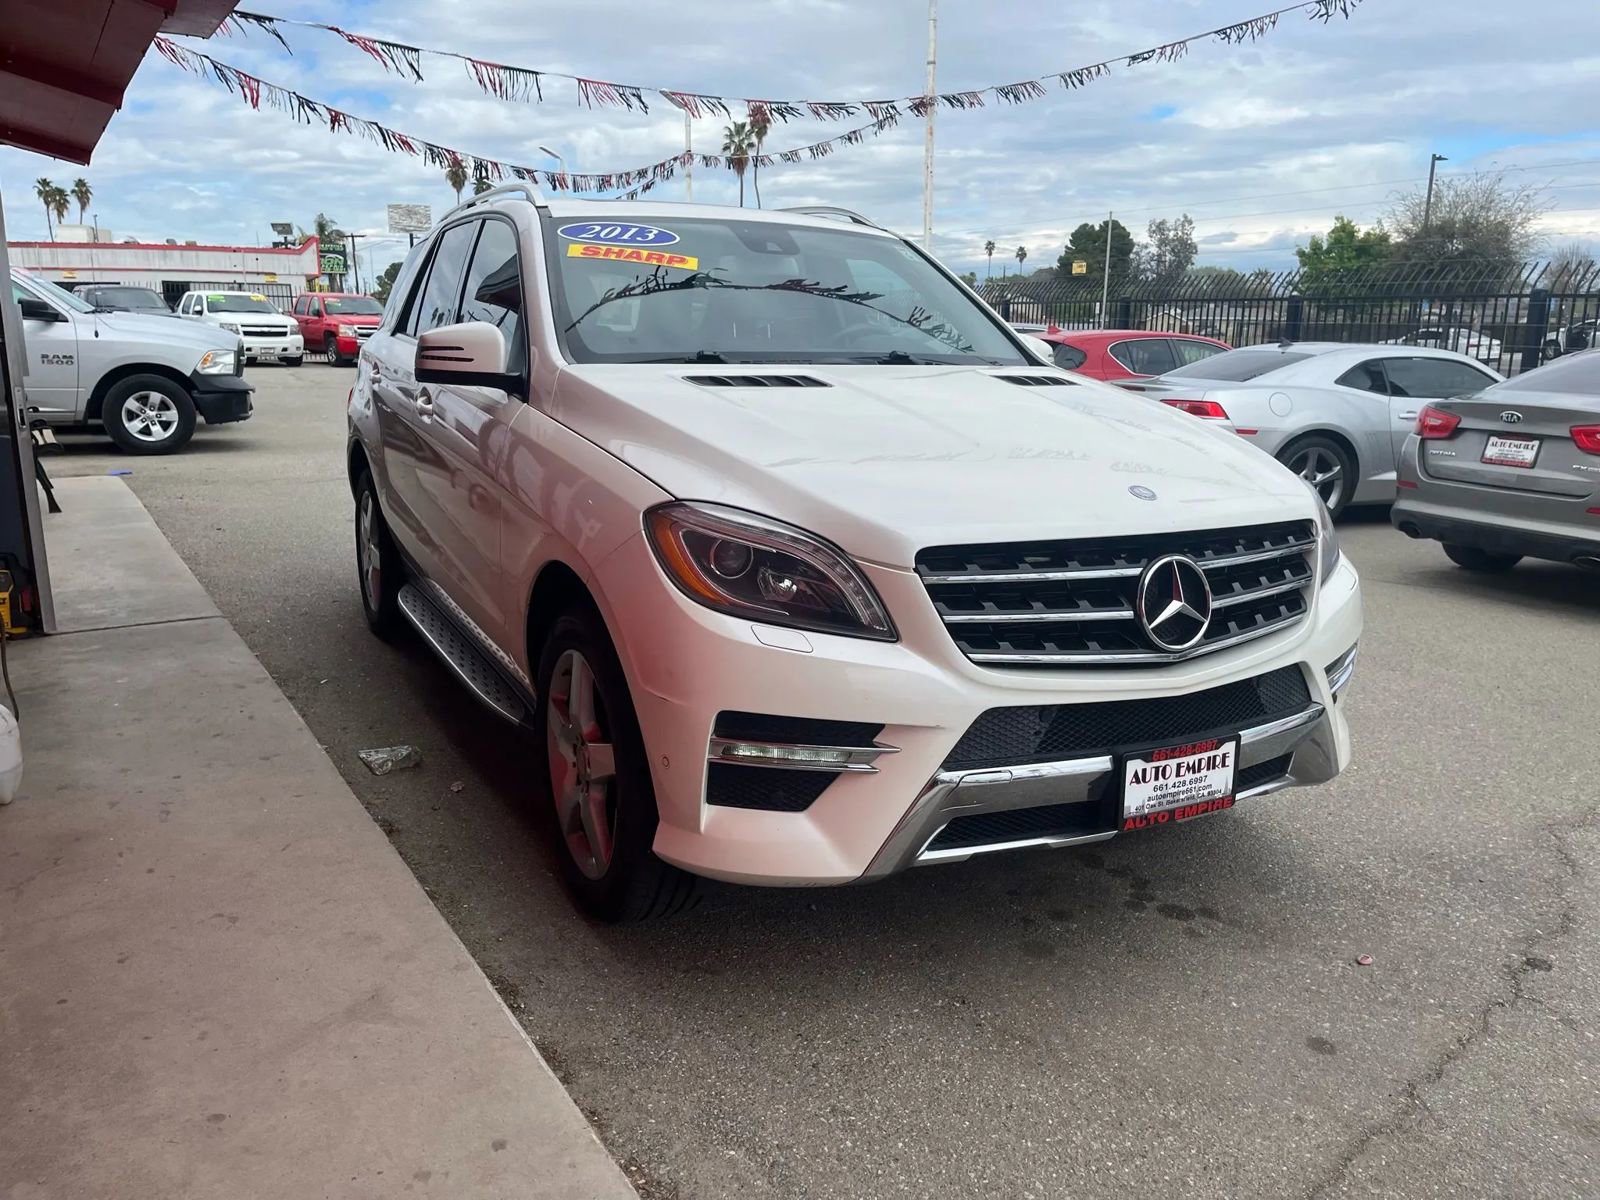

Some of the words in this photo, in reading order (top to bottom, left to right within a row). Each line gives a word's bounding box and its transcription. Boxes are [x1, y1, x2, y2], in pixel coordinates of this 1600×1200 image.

[578, 225, 660, 241] 2013
[580, 246, 689, 266] SHARP
[1502, 413, 1518, 422] KIA
[1129, 763, 1173, 786] AUTO
[1175, 752, 1230, 778] EMPIRE
[1147, 783, 1213, 802] autoempire661.com
[1153, 775, 1208, 793] 661.428.6997
[1124, 811, 1169, 831] AUTO
[1175, 796, 1233, 820] EMPIRE
